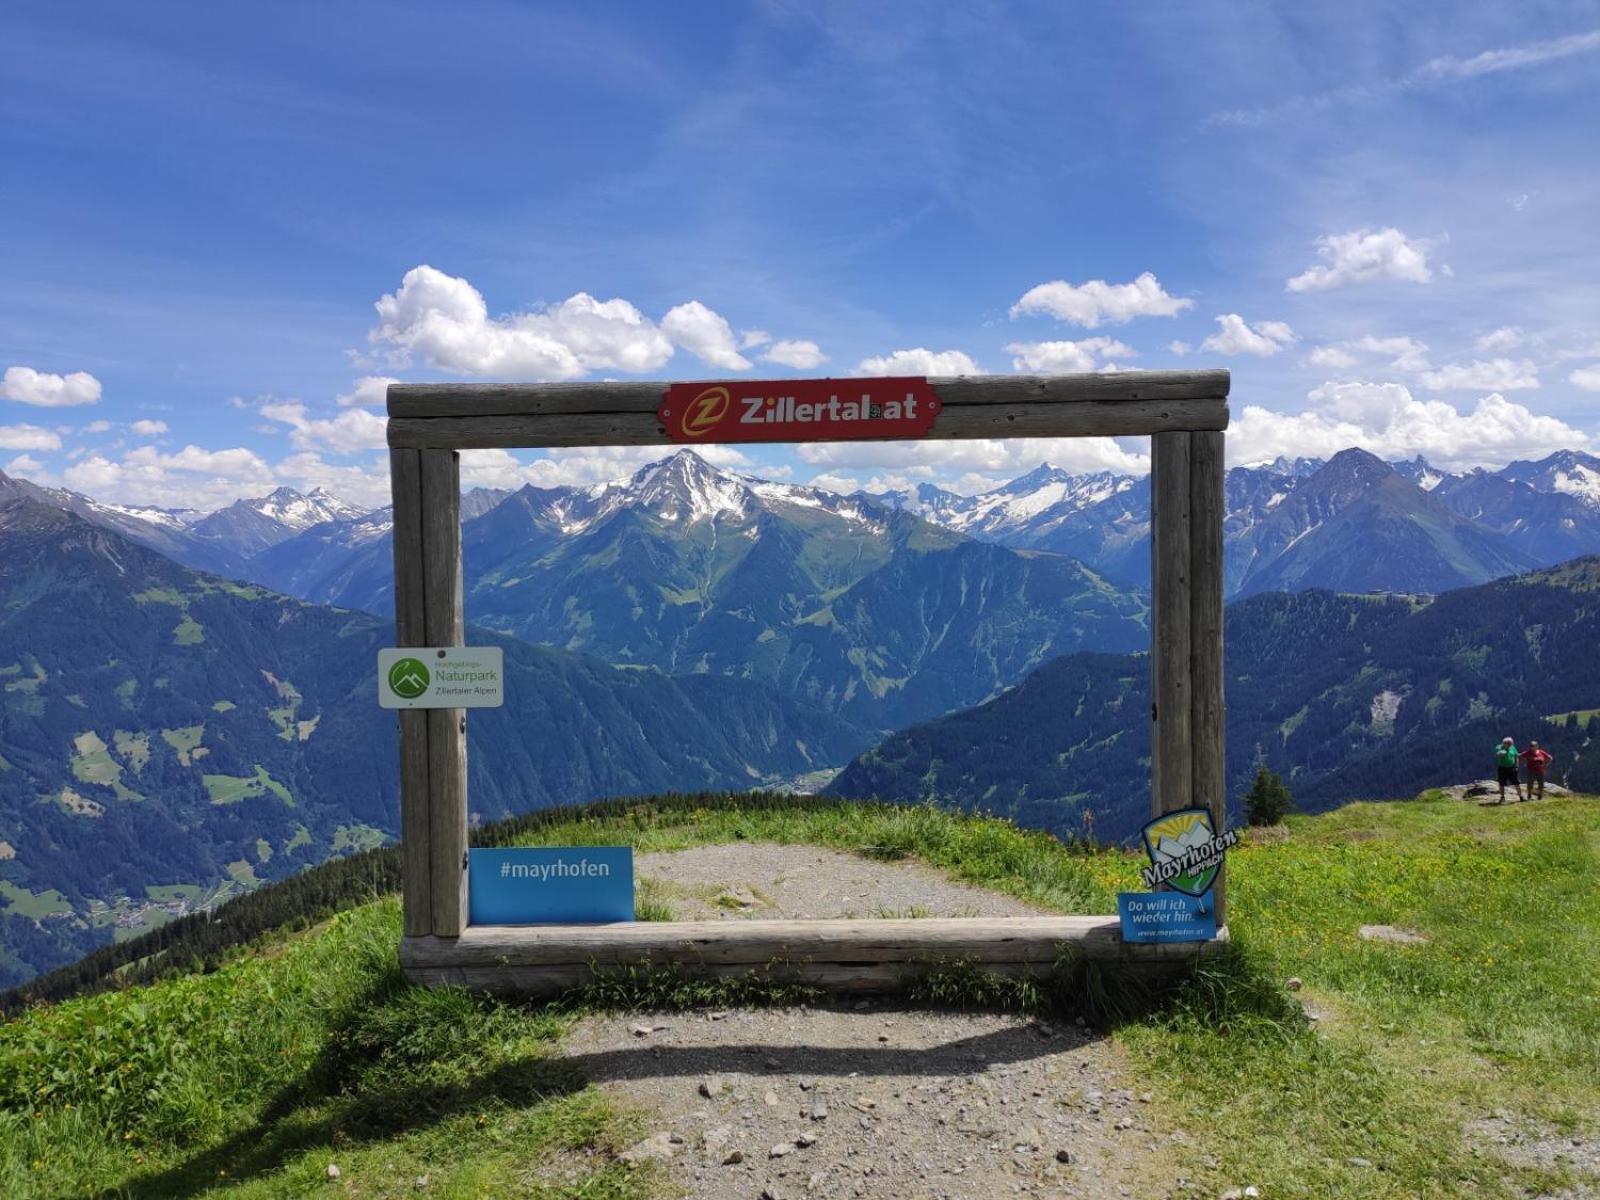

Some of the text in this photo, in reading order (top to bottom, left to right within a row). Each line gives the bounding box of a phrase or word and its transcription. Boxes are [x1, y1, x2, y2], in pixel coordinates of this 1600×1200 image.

[740, 393, 917, 424] Zillertalat
[435, 669, 497, 683] Naturpark
[435, 686, 497, 695] Zillertaler Alpen
[1143, 831, 1237, 888] Mayrhofen
[500, 859, 609, 881] #mayrhofen
[1147, 899, 1167, 911] will
[1169, 899, 1186, 910] ich
[1132, 911, 1195, 923] wieder hin.
